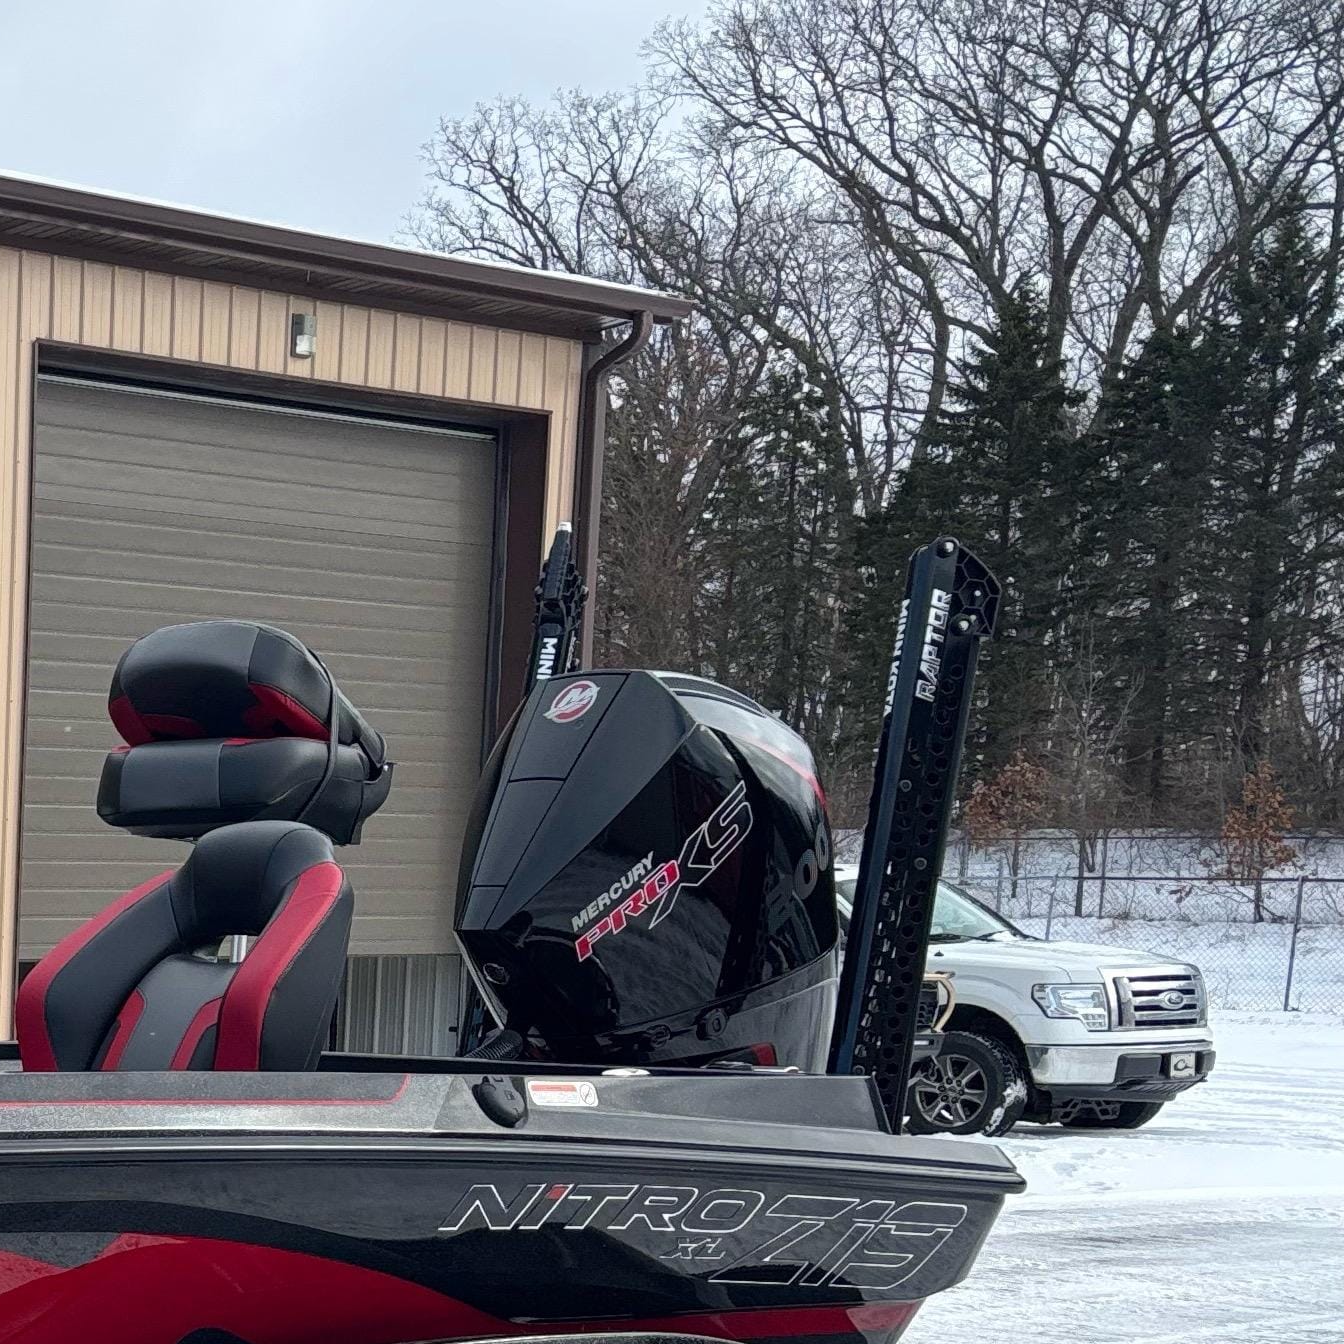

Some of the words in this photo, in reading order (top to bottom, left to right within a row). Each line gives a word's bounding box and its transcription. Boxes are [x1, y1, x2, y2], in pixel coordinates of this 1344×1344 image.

[914, 588, 953, 702] RAPTOR
[570, 850, 655, 933] MERCURY
[659, 1236, 727, 1260] XL
[707, 1194, 968, 1290] Z19
